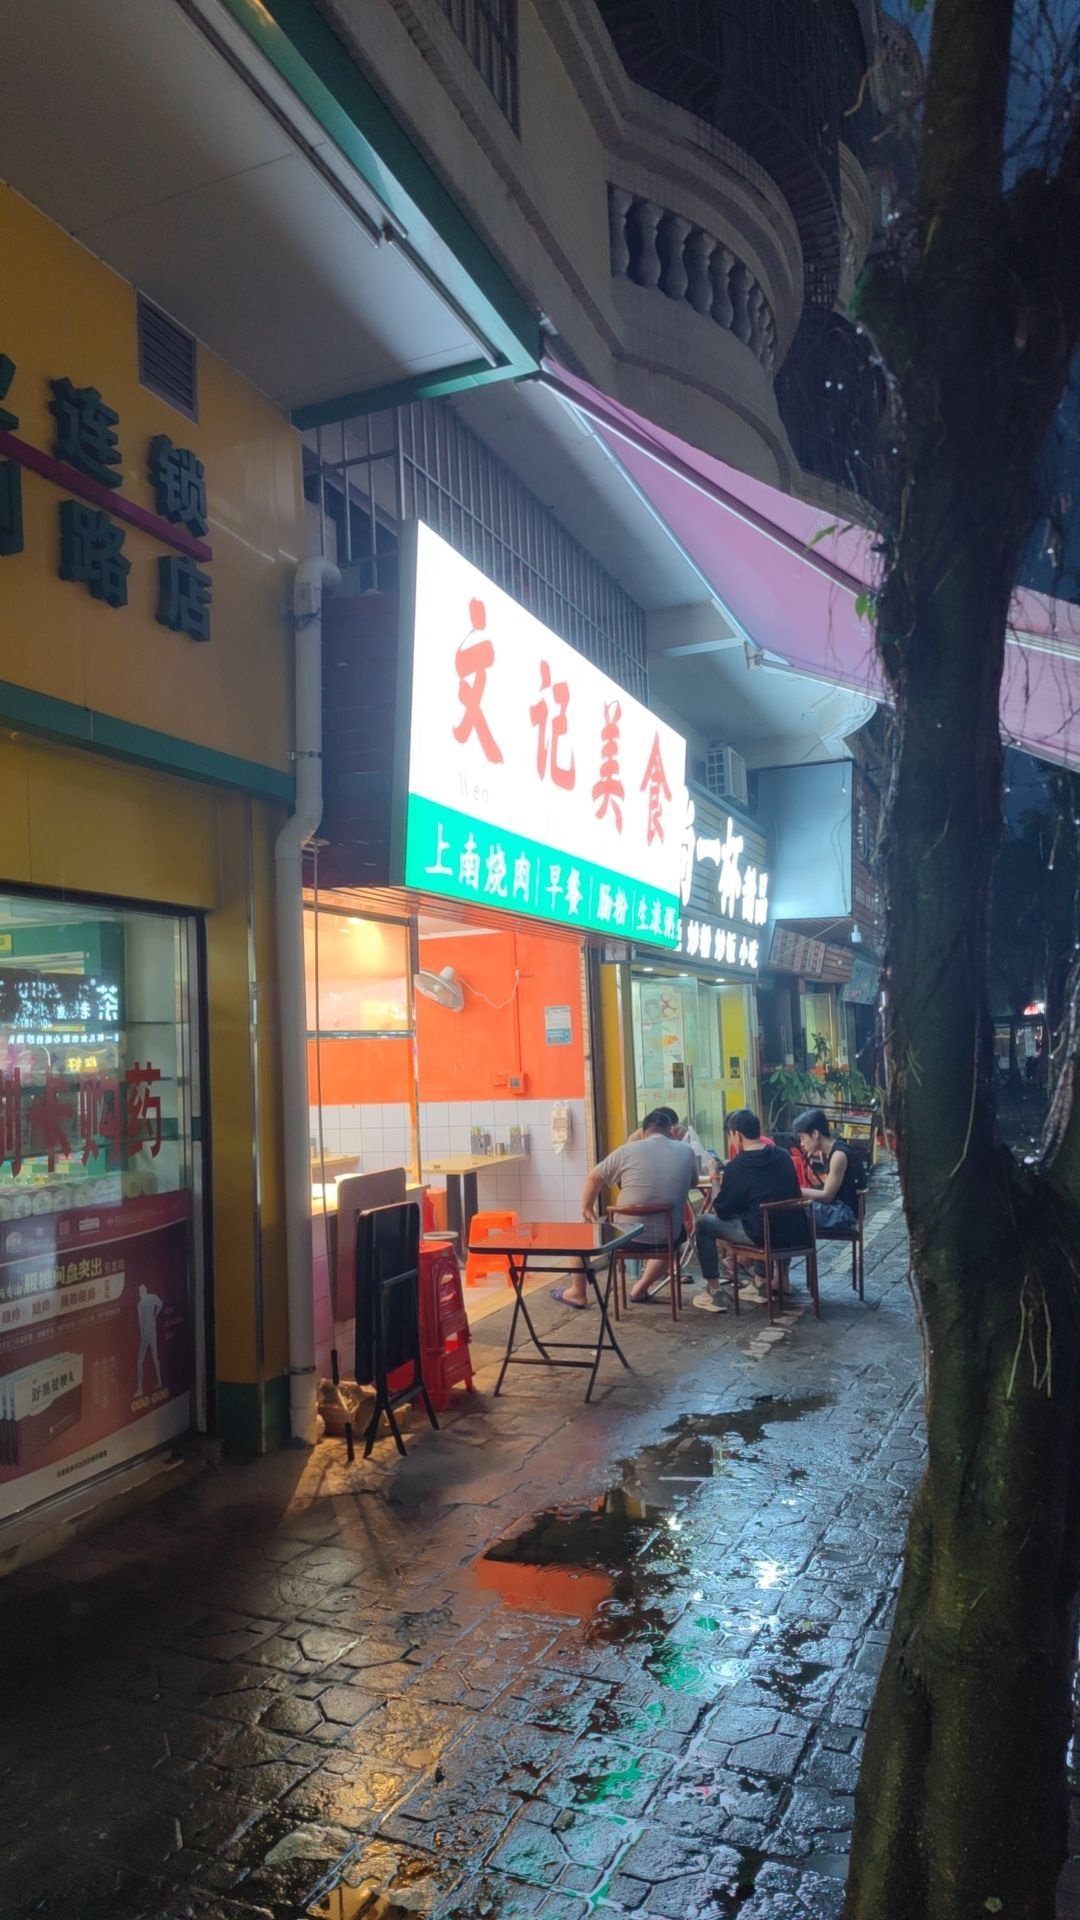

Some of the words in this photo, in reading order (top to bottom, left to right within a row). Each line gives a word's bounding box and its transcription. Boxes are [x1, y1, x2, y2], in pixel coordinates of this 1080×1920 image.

[453, 596, 672, 847] 文记美食
[425, 822, 531, 900] 上南烧肉
[544, 864, 584, 916] 早餐
[597, 882, 629, 926] 肠粉
